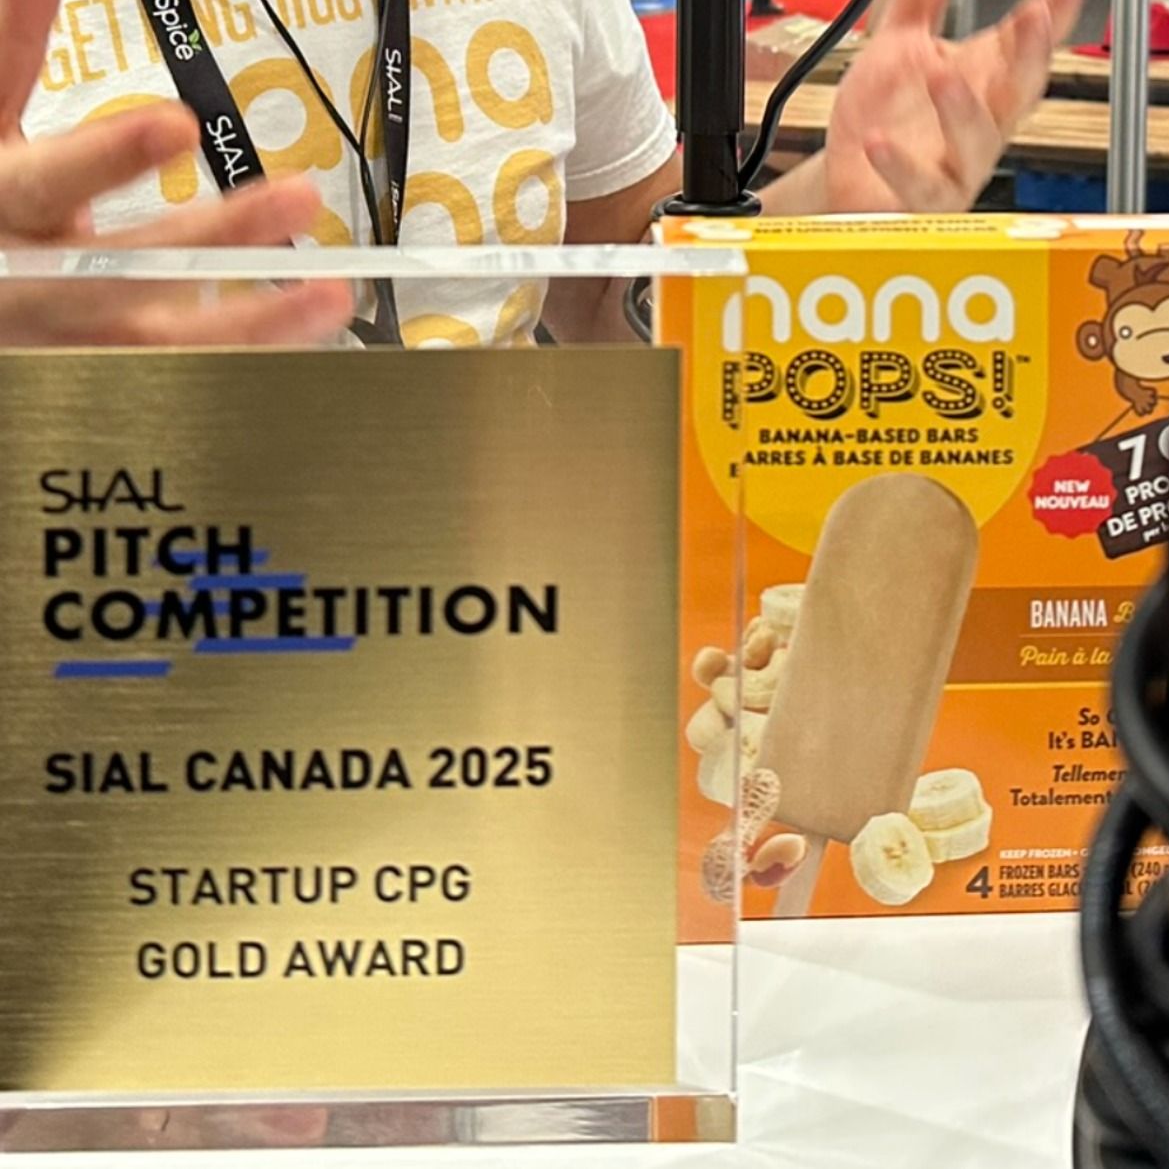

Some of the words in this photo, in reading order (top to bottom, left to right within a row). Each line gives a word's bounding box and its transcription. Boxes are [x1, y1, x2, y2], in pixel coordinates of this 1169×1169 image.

[722, 274, 1016, 352] nana
[722, 349, 1014, 429] POPS!
[759, 428, 921, 443] BANANA-BASED
[926, 428, 979, 443] BARS
[812, 446, 827, 465] À
[832, 450, 883, 466] BASE
[890, 450, 915, 465] DE
[920, 449, 1014, 465] BANANES
[1117, 434, 1147, 481] 7
[39, 469, 185, 513] SIAL
[1054, 480, 1091, 493] NEW
[1034, 496, 1110, 510] NOUVEAU
[1106, 512, 1139, 537] DE
[44, 526, 254, 577] PITCH
[43, 585, 559, 642] COMPETITION
[1030, 599, 1107, 628] BANANA
[1019, 645, 1068, 667] Pain
[1072, 647, 1087, 665] à
[1090, 647, 1112, 665] la
[1078, 708, 1100, 726] So
[1048, 731, 1076, 750] It's
[44, 751, 168, 794] SIAL
[185, 748, 412, 792] CANADA
[428, 746, 555, 789] 2025
[1028, 848, 1072, 858] FROZEN
[128, 866, 359, 906] STARTUP
[374, 864, 472, 903] CPG
[965, 865, 994, 899] 4
[1000, 864, 1044, 880] FROZEN
[1048, 863, 1080, 879] BARS
[1000, 883, 1045, 899] BARRES
[137, 941, 267, 980] GOLD
[283, 938, 465, 979] AWARD
